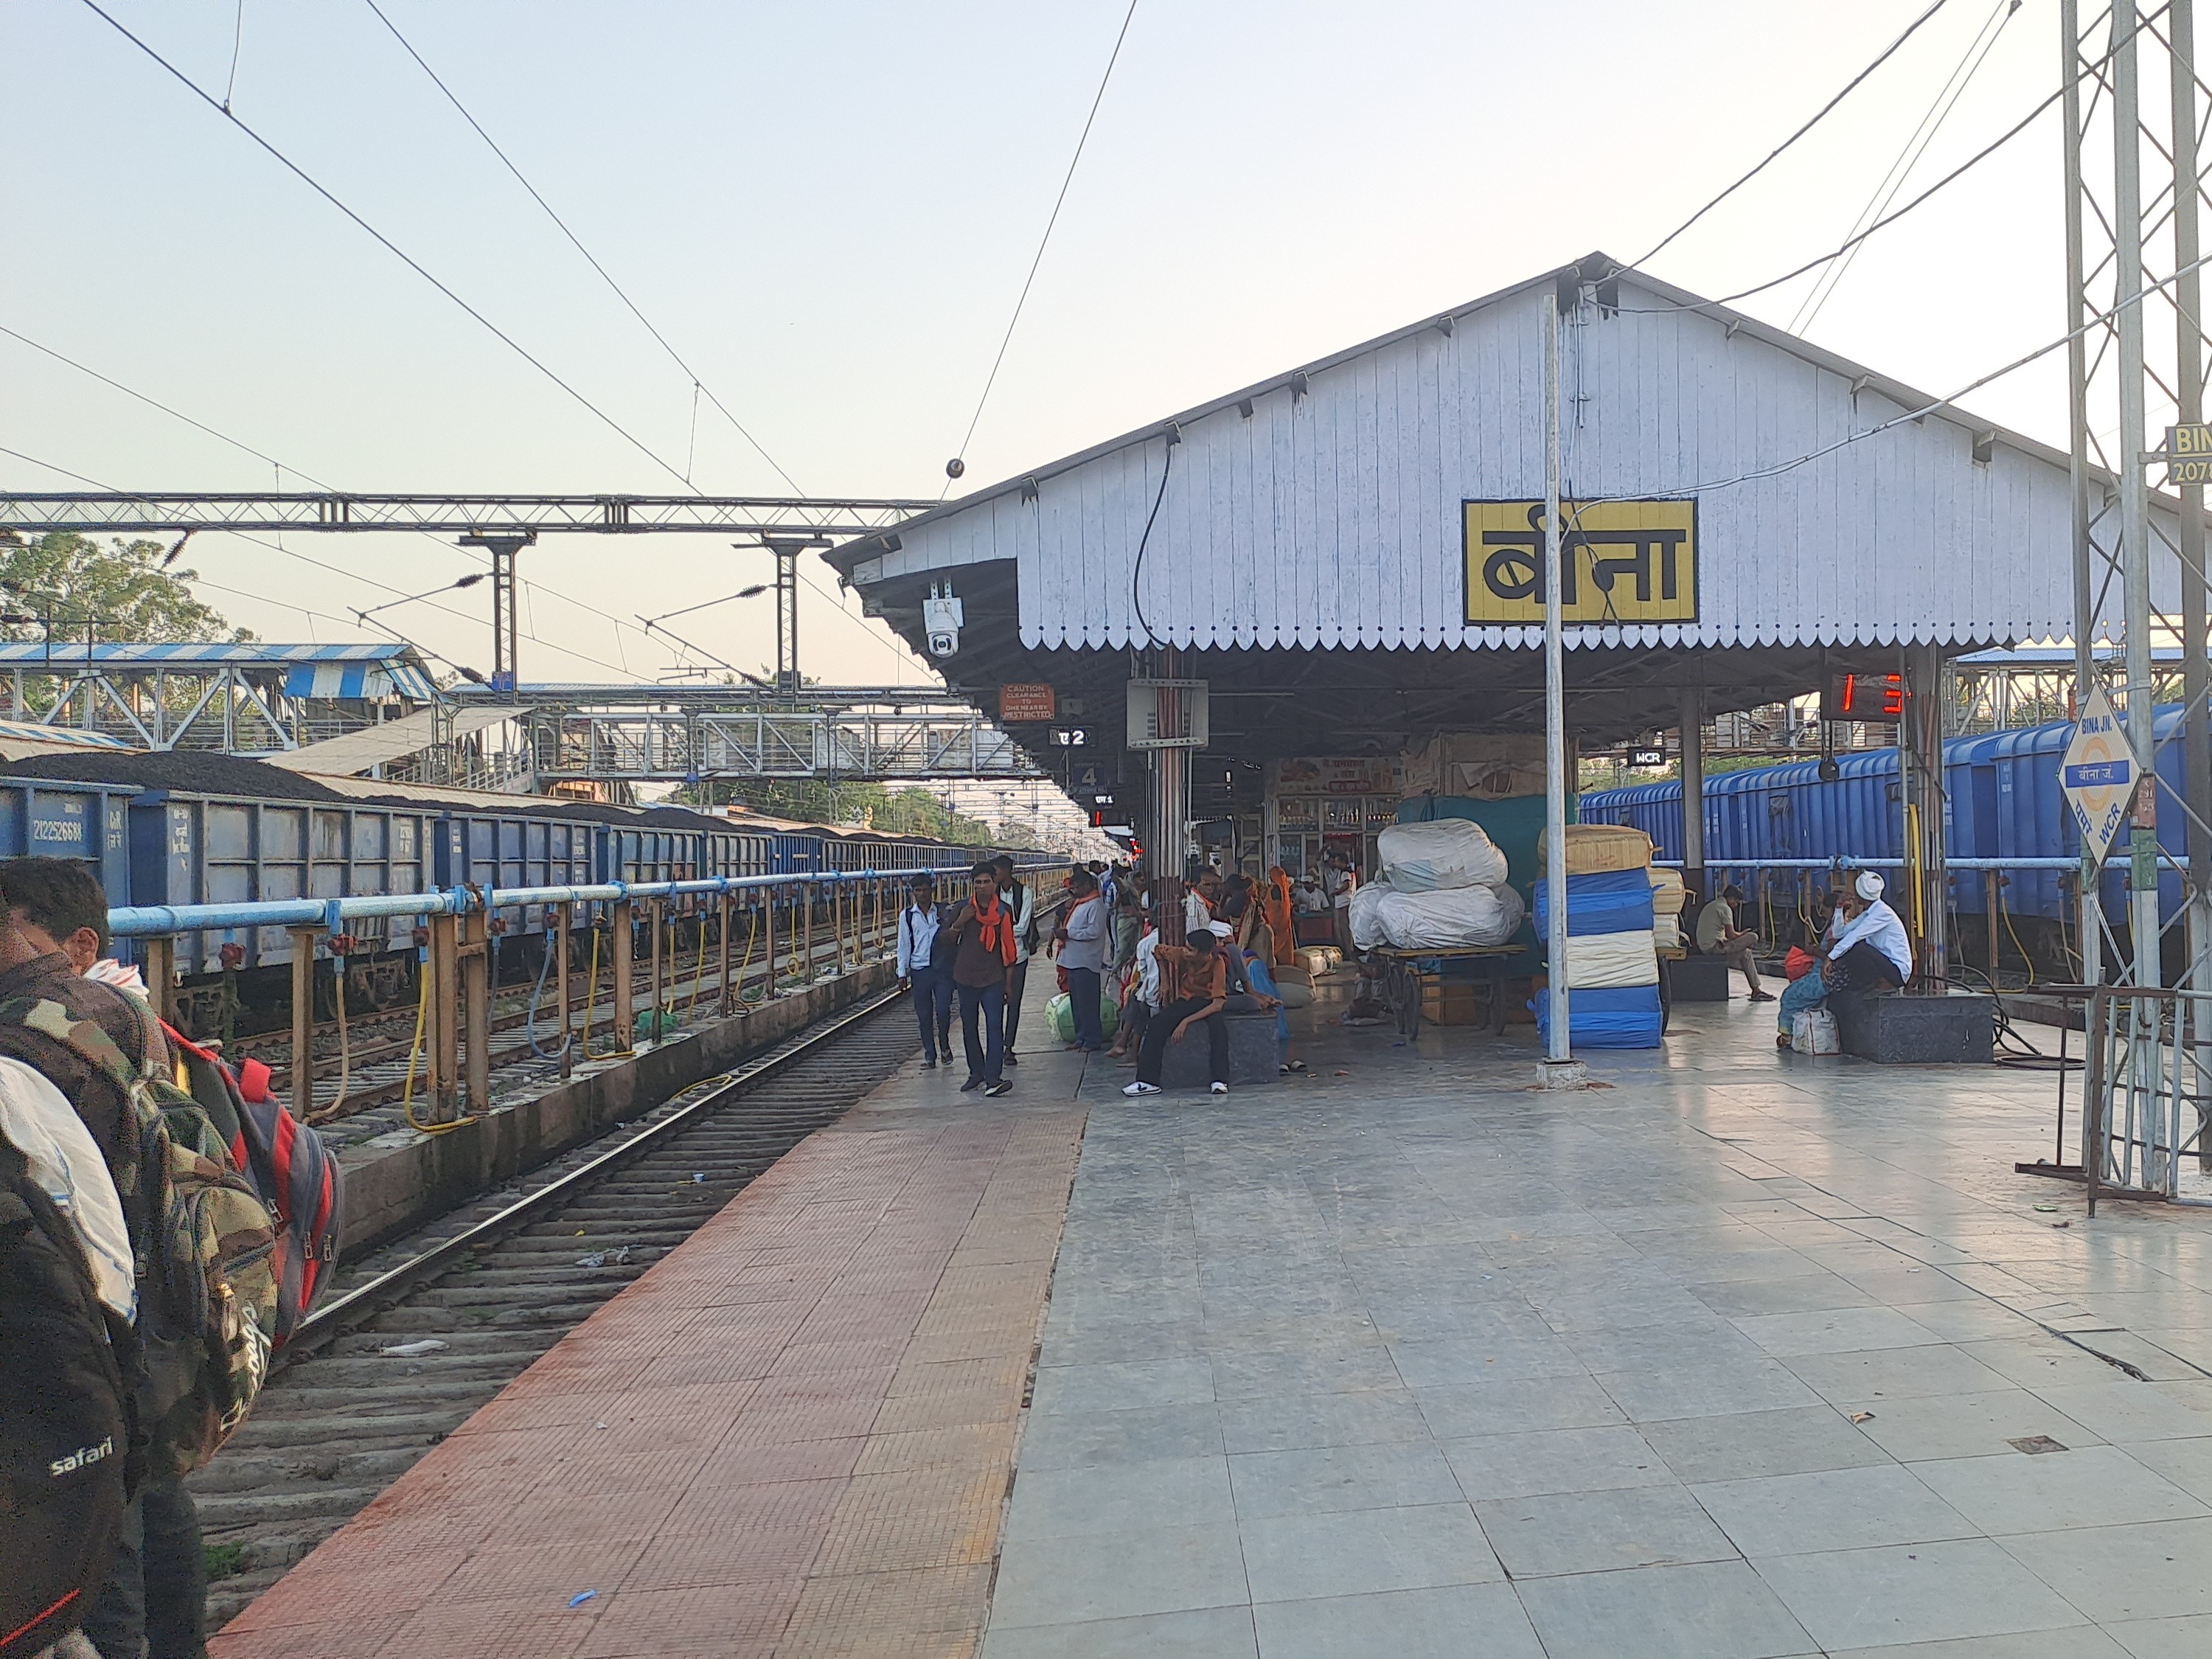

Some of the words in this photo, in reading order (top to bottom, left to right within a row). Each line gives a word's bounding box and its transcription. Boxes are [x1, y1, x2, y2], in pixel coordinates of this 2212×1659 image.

[1482, 504, 1687, 605] बीना
[1007, 684, 1045, 692] CAUTION
[1004, 711, 1051, 719] RESTRICTED
[2081, 715, 2099, 734] BINA
[2101, 714, 2112, 732] JN.
[1636, 752, 1660, 763] WCR
[1082, 767, 1096, 786] 4
[2078, 765, 2100, 782] बीना
[2098, 802, 2121, 845] WCR
[50, 1435, 113, 1475] safari
